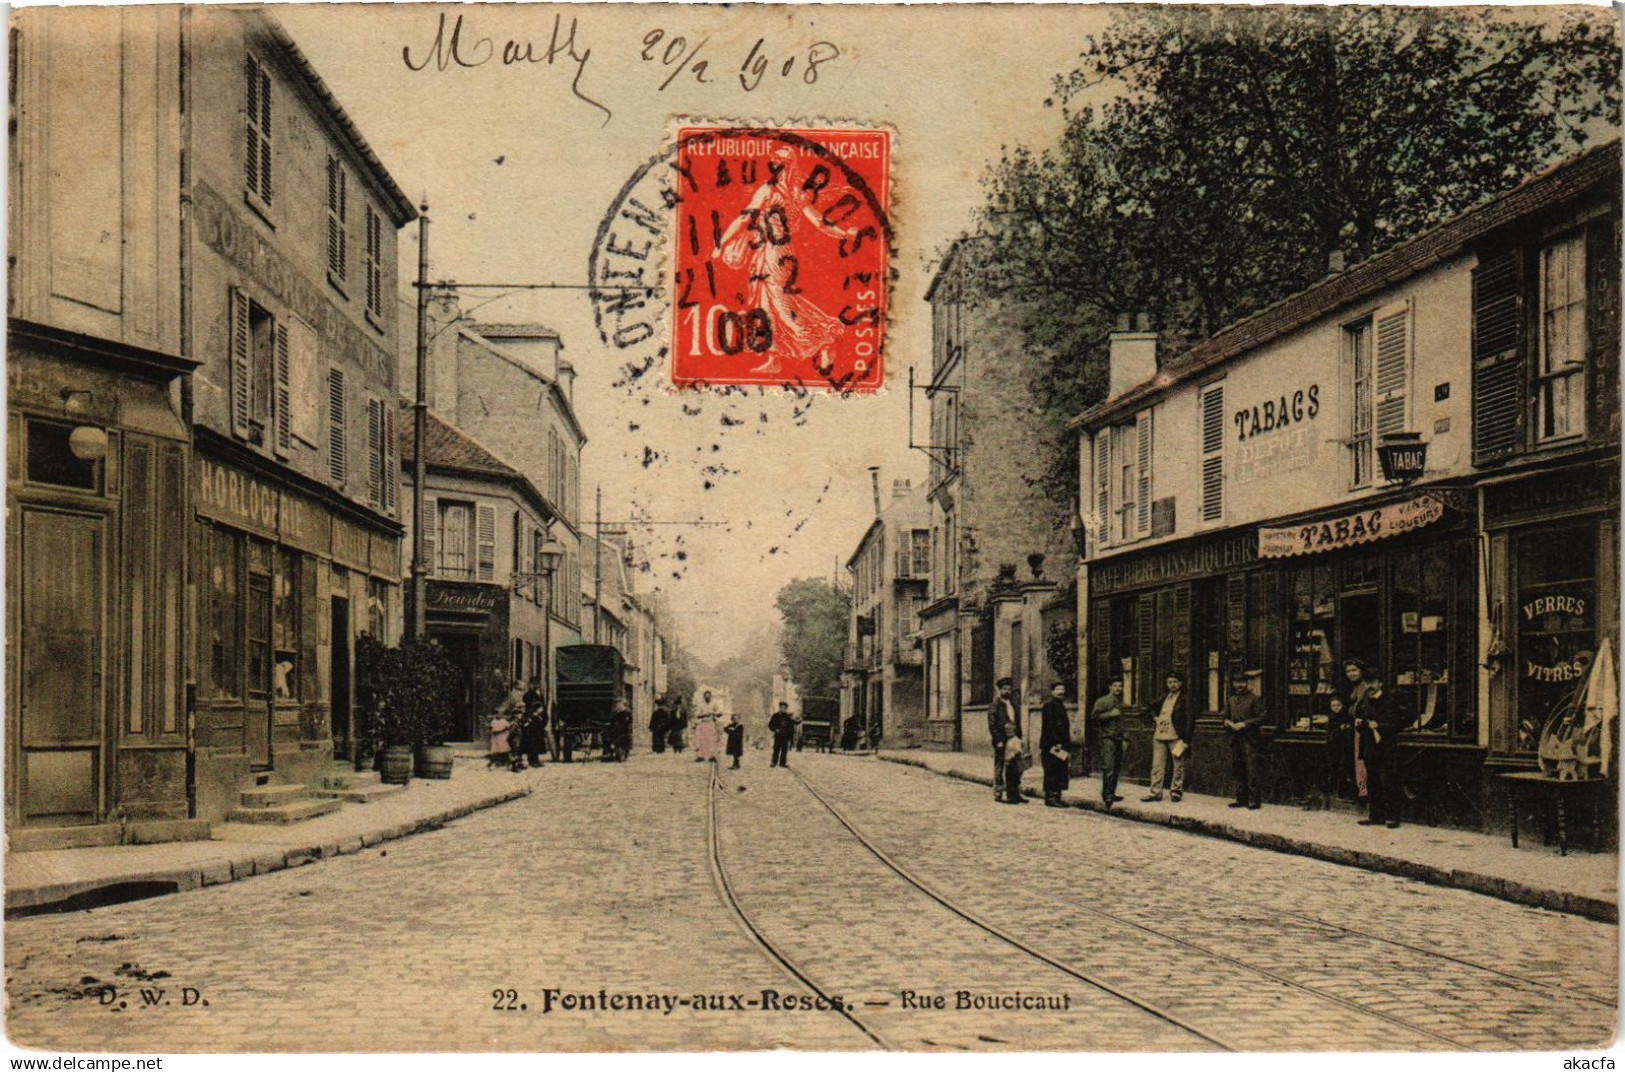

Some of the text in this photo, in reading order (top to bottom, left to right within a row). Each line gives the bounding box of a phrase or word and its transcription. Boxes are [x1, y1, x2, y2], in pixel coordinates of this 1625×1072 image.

[1234, 384, 1320, 441] TABACS
[1392, 451, 1424, 470] TABAC
[1300, 510, 1383, 549] TABAC
[1389, 506, 1438, 530] LIQUEURS
[1523, 595, 1585, 620] VERRES
[1527, 661, 1583, 682] VITRES
